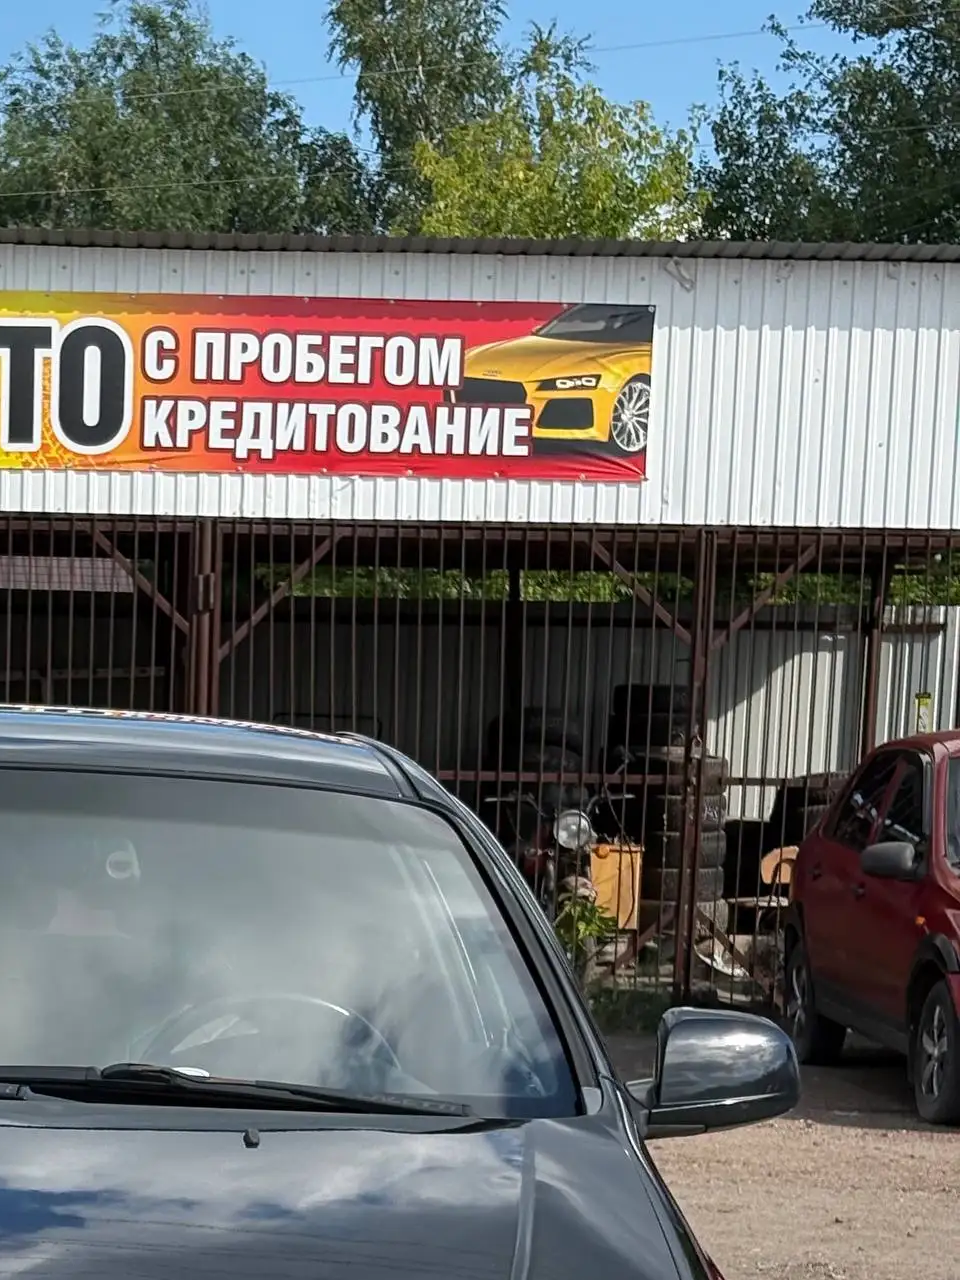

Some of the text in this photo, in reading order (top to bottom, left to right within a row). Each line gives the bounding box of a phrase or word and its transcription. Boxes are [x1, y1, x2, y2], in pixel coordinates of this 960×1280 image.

[144, 330, 462, 386] С ПРОБЕГОМ
[143, 399, 532, 459] КРЕДИТОВАНИЕ
